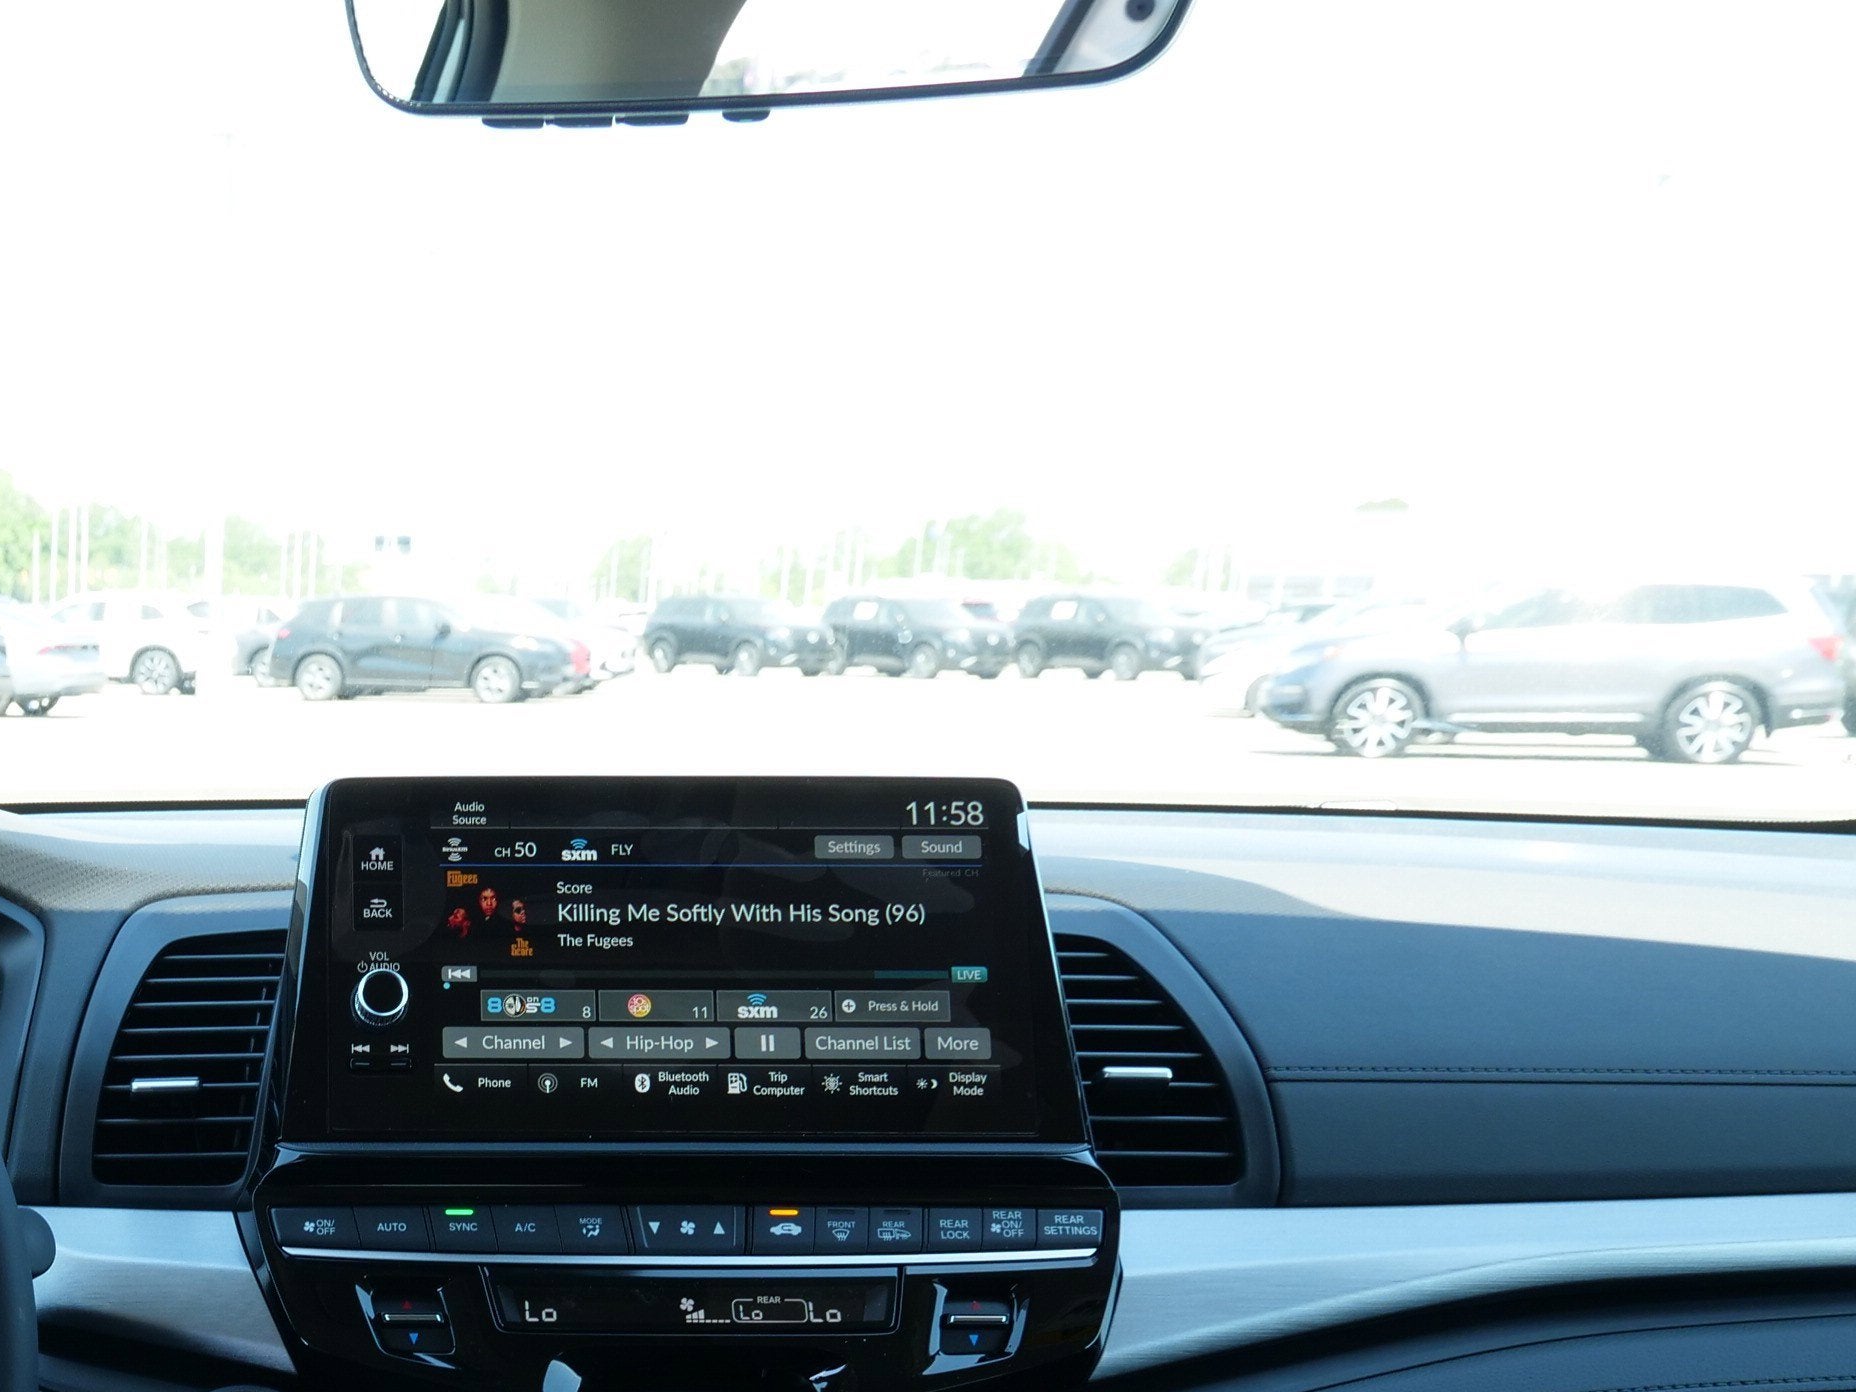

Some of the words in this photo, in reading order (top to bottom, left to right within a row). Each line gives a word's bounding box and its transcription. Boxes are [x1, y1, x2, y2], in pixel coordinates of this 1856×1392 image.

[454, 802, 485, 813] Audio
[905, 801, 984, 826] 11:58
[452, 815, 487, 825] Source
[494, 847, 511, 857] CH
[514, 842, 537, 857] 50
[561, 849, 597, 862] sxm
[611, 844, 633, 856] FLY
[828, 840, 881, 854] Settings
[921, 841, 963, 853] Sound
[361, 861, 394, 871] HOME
[556, 881, 593, 894] Score
[363, 908, 393, 919] BACK
[558, 903, 620, 925] Killing
[628, 904, 660, 922] Me
[667, 904, 725, 925] Softly
[732, 904, 783, 922] With
[790, 904, 821, 922] His
[828, 904, 879, 926] Song
[886, 903, 926, 925] (96)
[558, 934, 582, 947] The
[586, 934, 633, 949] Fugees
[369, 952, 390, 962] VOL
[369, 963, 400, 972] AUDIO
[957, 969, 982, 980] LIVE
[737, 1005, 778, 1019] sxm
[868, 1000, 897, 1012] Press
[900, 1000, 909, 1012] &
[912, 1000, 939, 1012] Hold
[582, 1006, 591, 1019] 8
[692, 1007, 708, 1019] 11
[810, 1007, 828, 1019] 26
[482, 1035, 546, 1050] Channel
[626, 1035, 694, 1053] Hip-Hop
[815, 1036, 879, 1051] Channel
[884, 1036, 911, 1051] List
[937, 1036, 979, 1051] More
[478, 1077, 512, 1089] Phone
[580, 1077, 598, 1088] FM
[658, 1071, 709, 1083] Bluetooth
[768, 1071, 788, 1085] Trip
[858, 1071, 888, 1083] Smart
[949, 1072, 987, 1085] Display
[668, 1084, 700, 1096] Audio
[753, 1085, 805, 1098] Computer
[849, 1085, 899, 1097] Shortcuts
[953, 1085, 984, 1096] Mode
[579, 1217, 602, 1225] MODE
[992, 1210, 1022, 1220] REAR
[1054, 1214, 1084, 1224] REAR
[316, 1219, 335, 1228] ON/
[377, 1222, 407, 1232] AUTO
[449, 1222, 478, 1232] SYNC
[515, 1223, 536, 1233] A/C
[827, 1221, 856, 1229] FRONT
[940, 1219, 969, 1229] REAR
[1001, 1219, 1022, 1229] ON/
[316, 1227, 336, 1236] OFF
[940, 1230, 970, 1240] LOCK
[1002, 1227, 1025, 1238] OFF
[1044, 1225, 1098, 1236] SETTINGS
[757, 1295, 781, 1304] REAR
